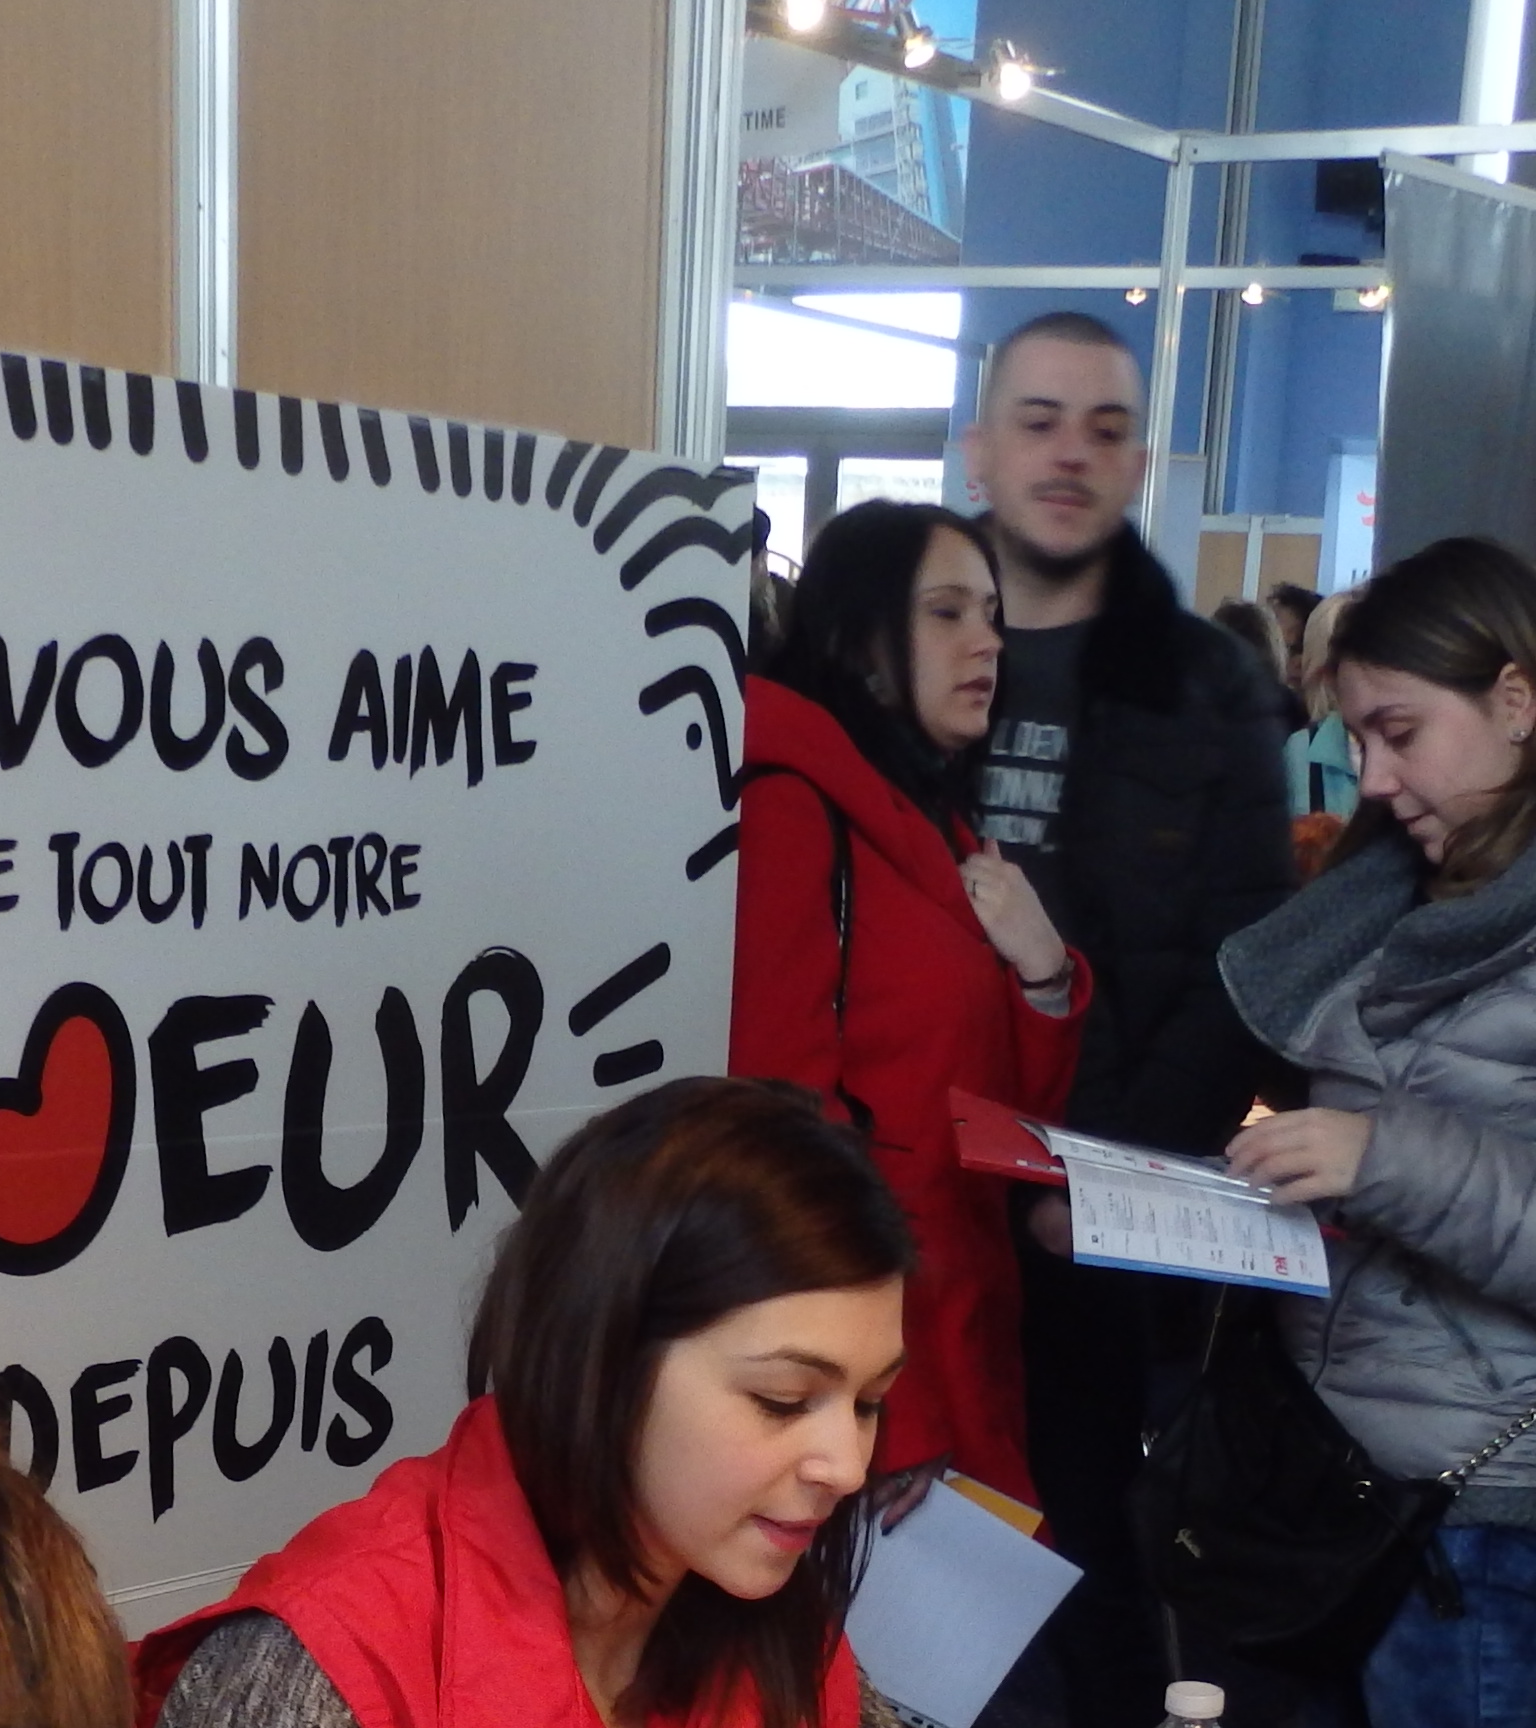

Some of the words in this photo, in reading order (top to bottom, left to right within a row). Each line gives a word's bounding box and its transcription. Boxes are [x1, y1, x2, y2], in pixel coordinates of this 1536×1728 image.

[328, 645, 538, 786] AIME
[50, 833, 213, 929] TOUT
[241, 833, 421, 924] NOTRE
